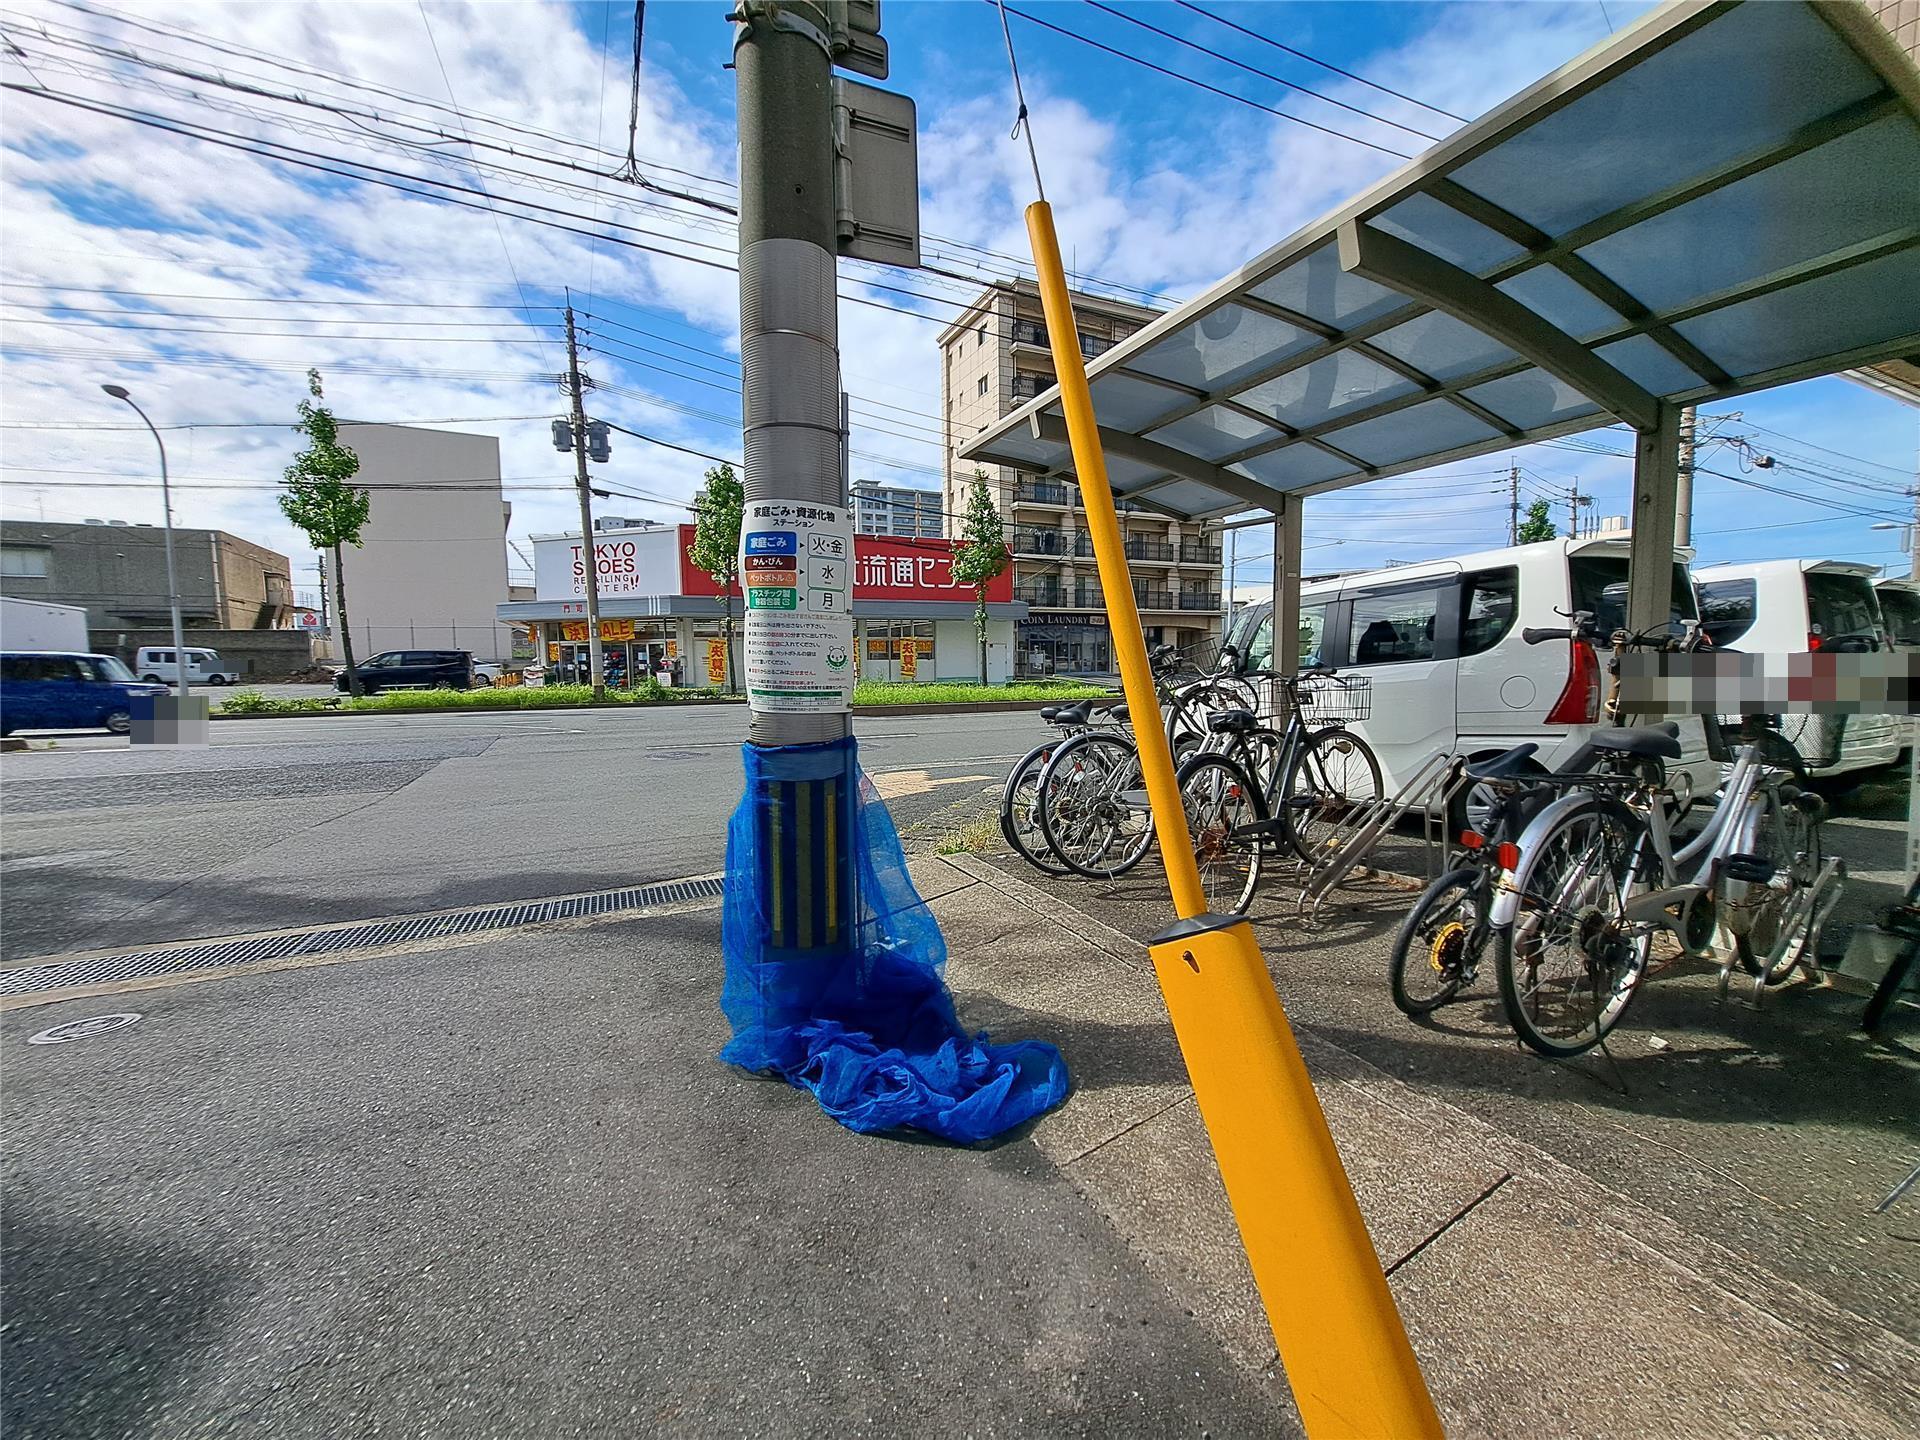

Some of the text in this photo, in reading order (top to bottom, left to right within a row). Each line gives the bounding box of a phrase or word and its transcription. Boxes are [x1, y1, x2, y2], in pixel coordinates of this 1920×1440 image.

[753, 506, 836, 523] 家庭ごみ・資源化物
[773, 519, 815, 528] ステーション
[750, 537, 787, 549] 家庭ごみ
[812, 537, 843, 554] 火・金
[573, 558, 635, 576] SOES
[752, 557, 784, 566] かん・びん
[750, 574, 784, 583] ペットボトル
[821, 565, 834, 580] 水
[822, 593, 833, 607] 月
